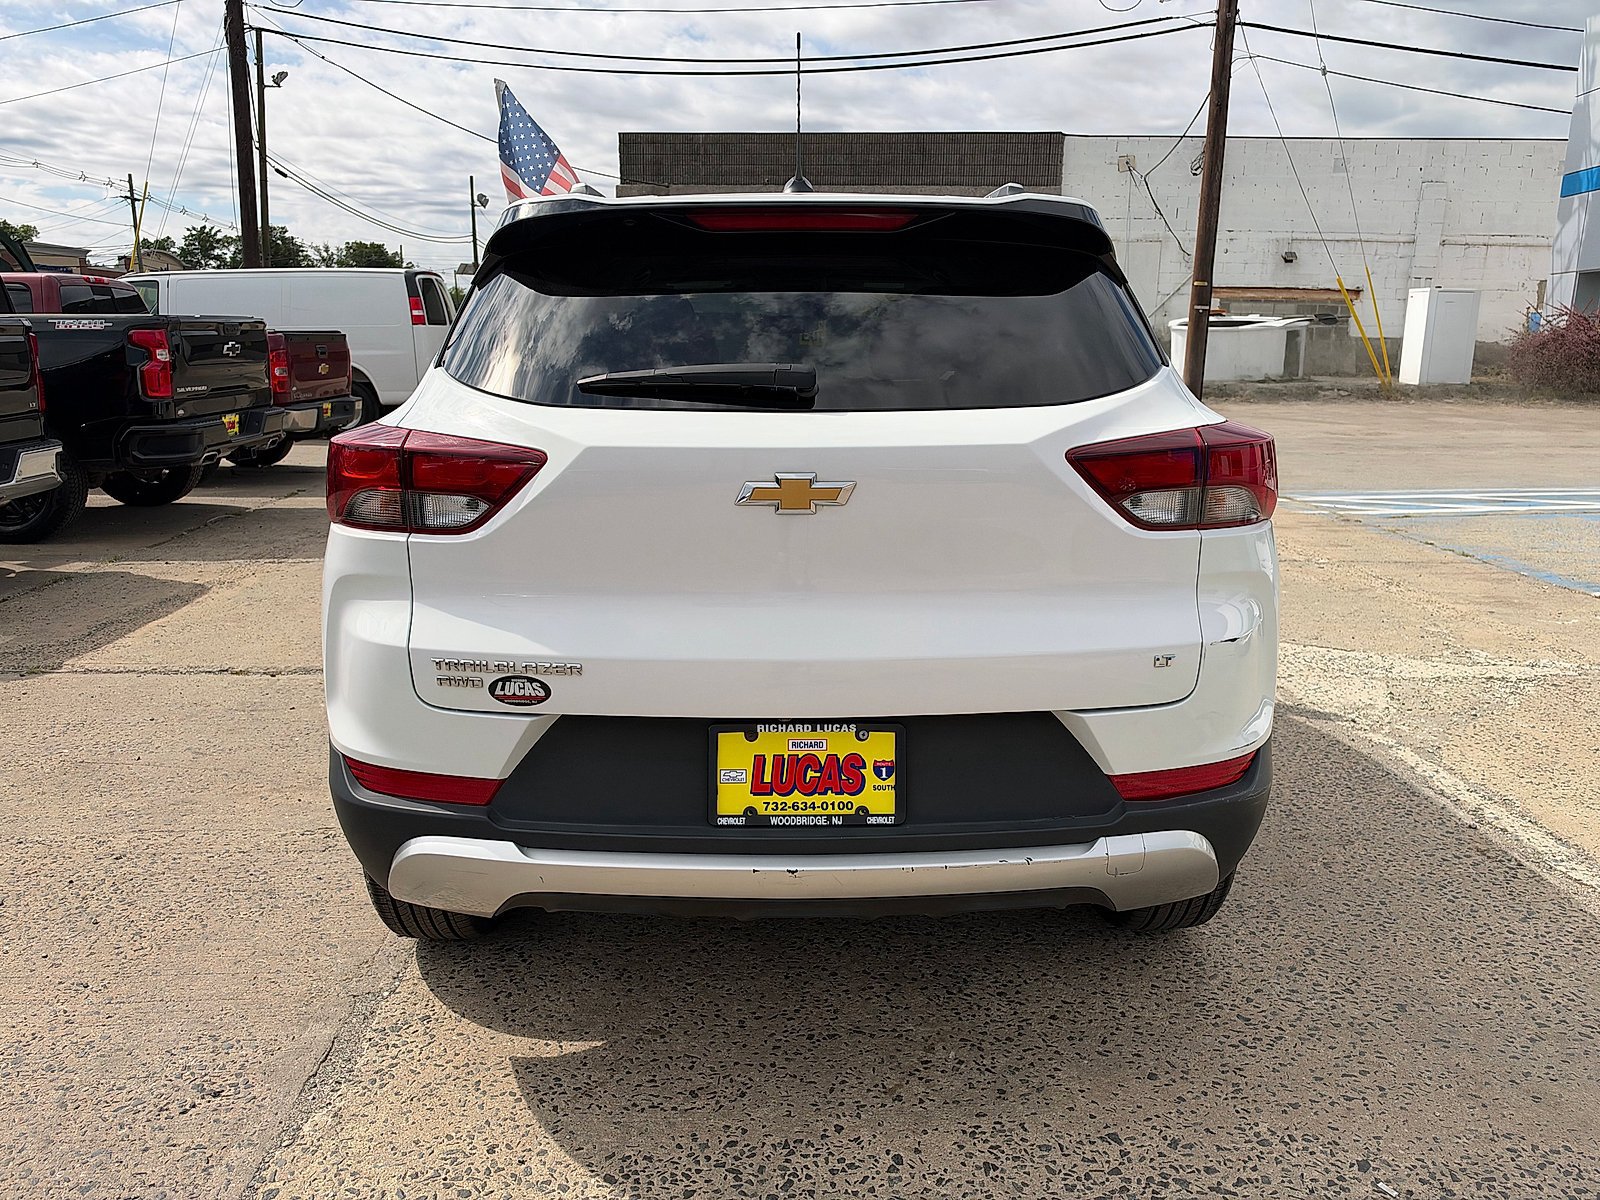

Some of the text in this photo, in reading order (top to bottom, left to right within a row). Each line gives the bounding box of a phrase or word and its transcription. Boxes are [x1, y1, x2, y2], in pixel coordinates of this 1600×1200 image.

[1153, 653, 1177, 668] LT
[430, 657, 583, 676] TRAILBLAZER
[435, 674, 484, 689] AWD
[494, 681, 546, 697] LUCAS
[757, 723, 857, 733] RICHARD LUCAS
[791, 741, 824, 749] RICHARD
[750, 753, 867, 797] LUCAS
[879, 767, 889, 779] 1
[872, 784, 896, 792] SOUTH
[762, 801, 854, 812] 732-634-0100
[717, 817, 746, 825] CHEVROLET
[770, 816, 843, 825] WOODBRIDGE, NJ
[866, 816, 895, 824] CHEVROLET
